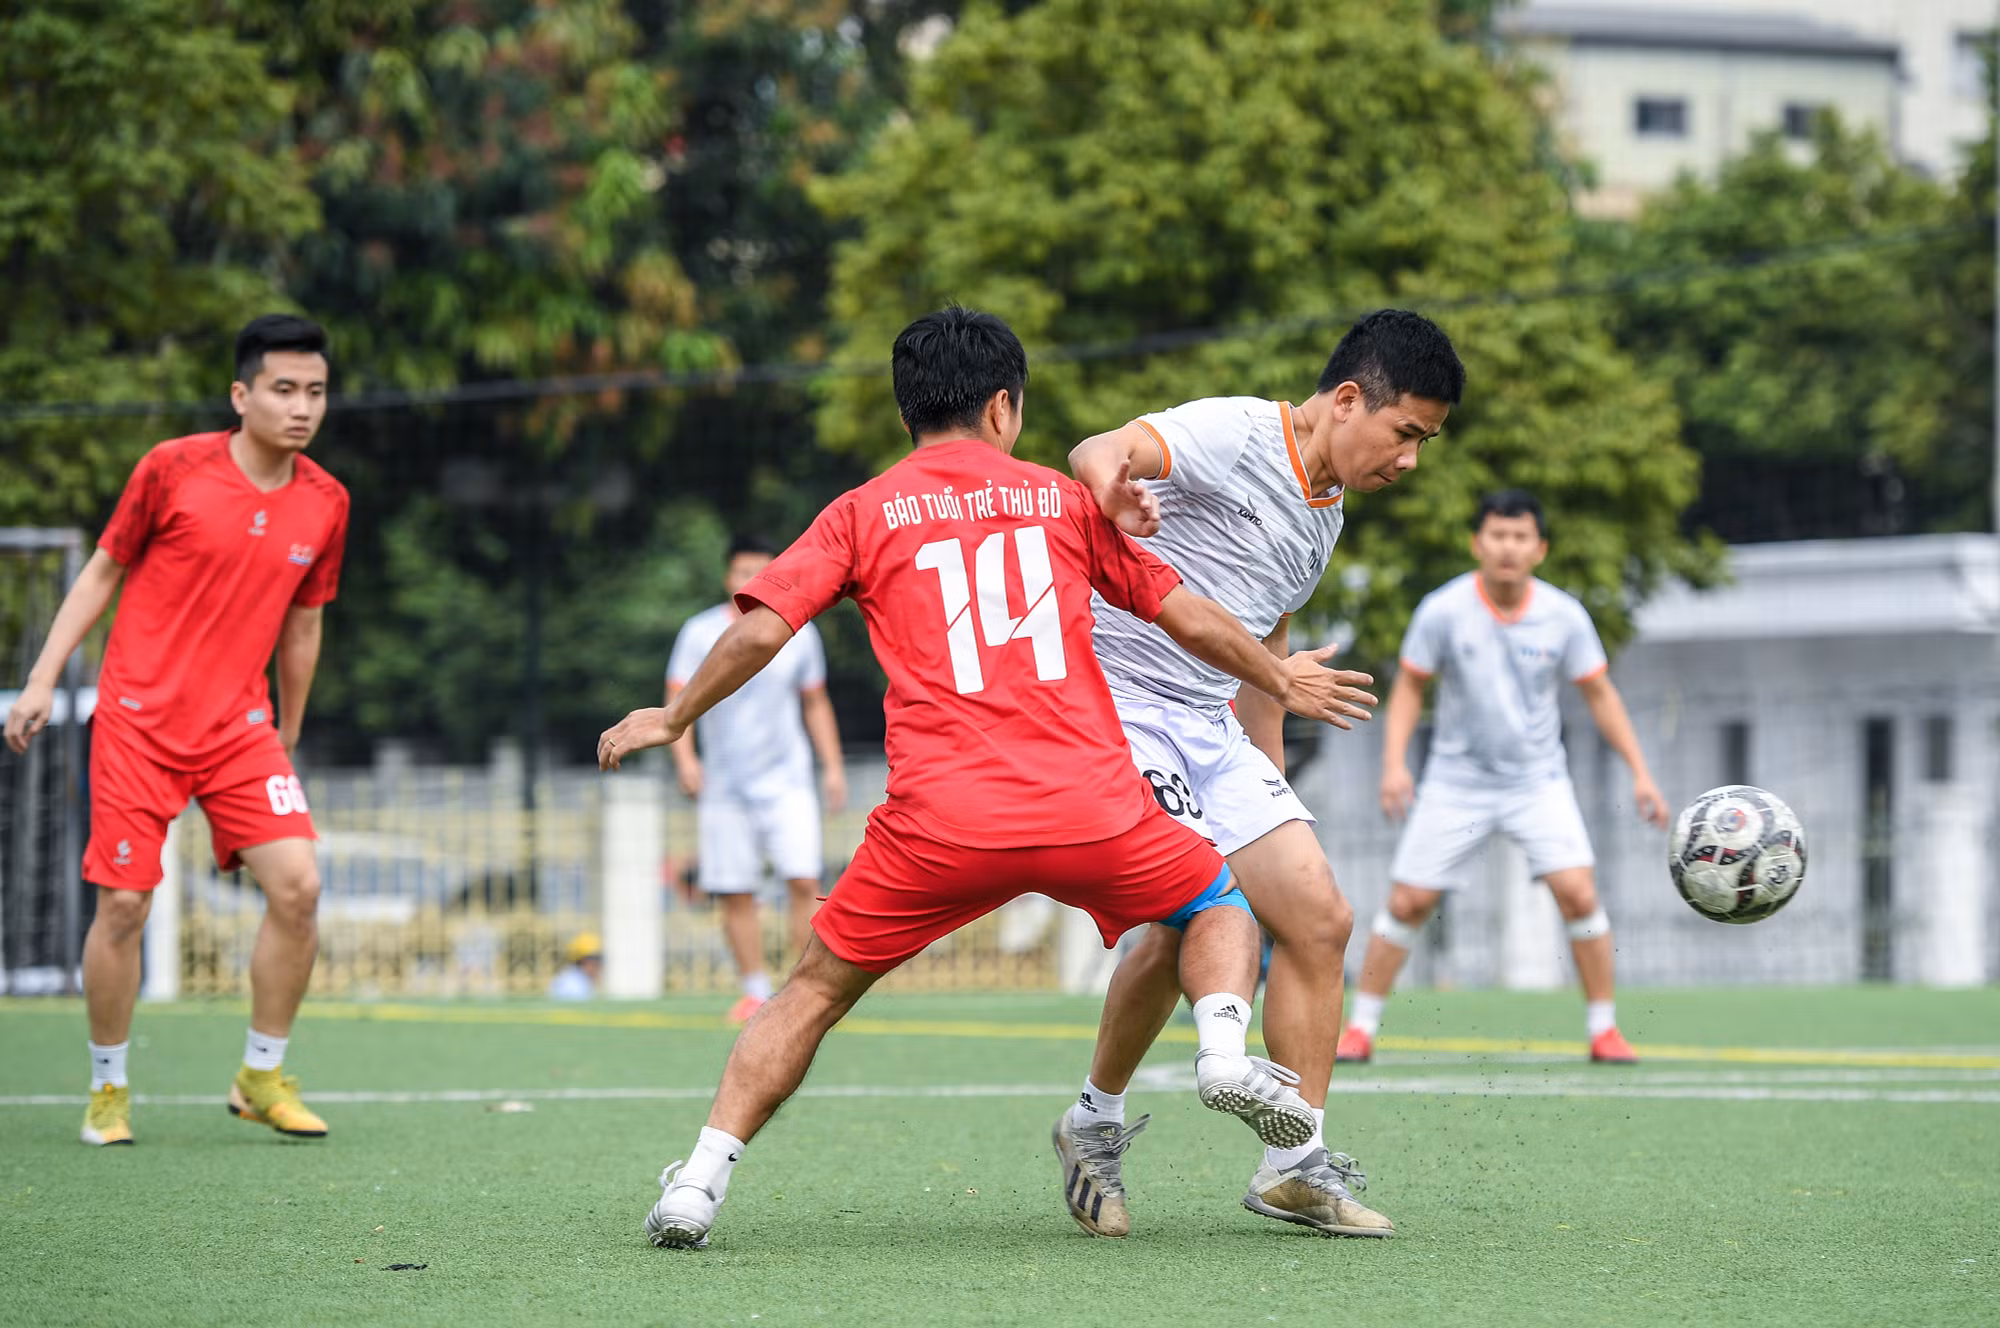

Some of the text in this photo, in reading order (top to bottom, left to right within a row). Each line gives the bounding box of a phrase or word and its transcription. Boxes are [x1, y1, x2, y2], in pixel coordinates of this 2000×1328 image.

[882, 480, 1062, 530] BÁO TUỔI TRẺ THỦ ĐÔ
[915, 525, 1067, 694] 14
